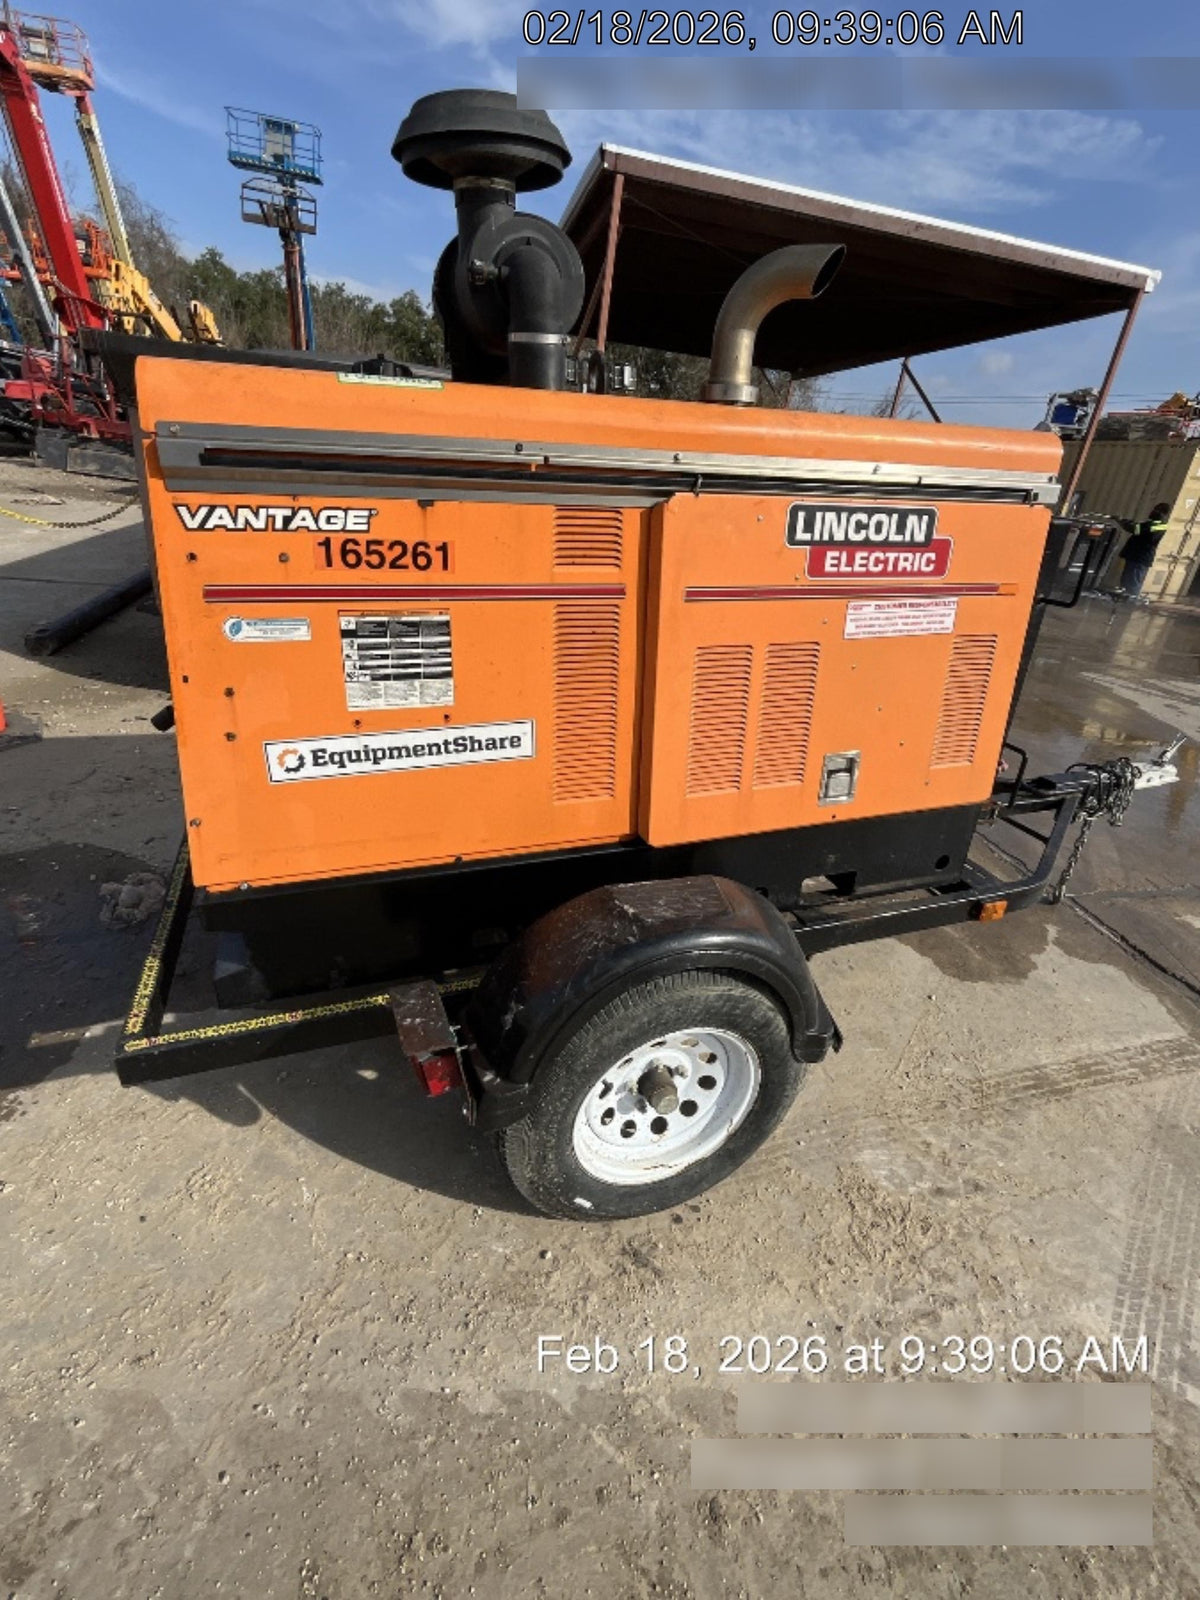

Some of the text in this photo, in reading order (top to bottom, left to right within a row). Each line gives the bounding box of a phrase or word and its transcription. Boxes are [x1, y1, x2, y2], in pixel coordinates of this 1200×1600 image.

[174, 504, 370, 532] VANTAGE
[794, 511, 929, 543] LINCOLN
[317, 536, 450, 571] 165261
[824, 550, 937, 573] ELECTRIC
[311, 733, 522, 768] EquipmentShare
